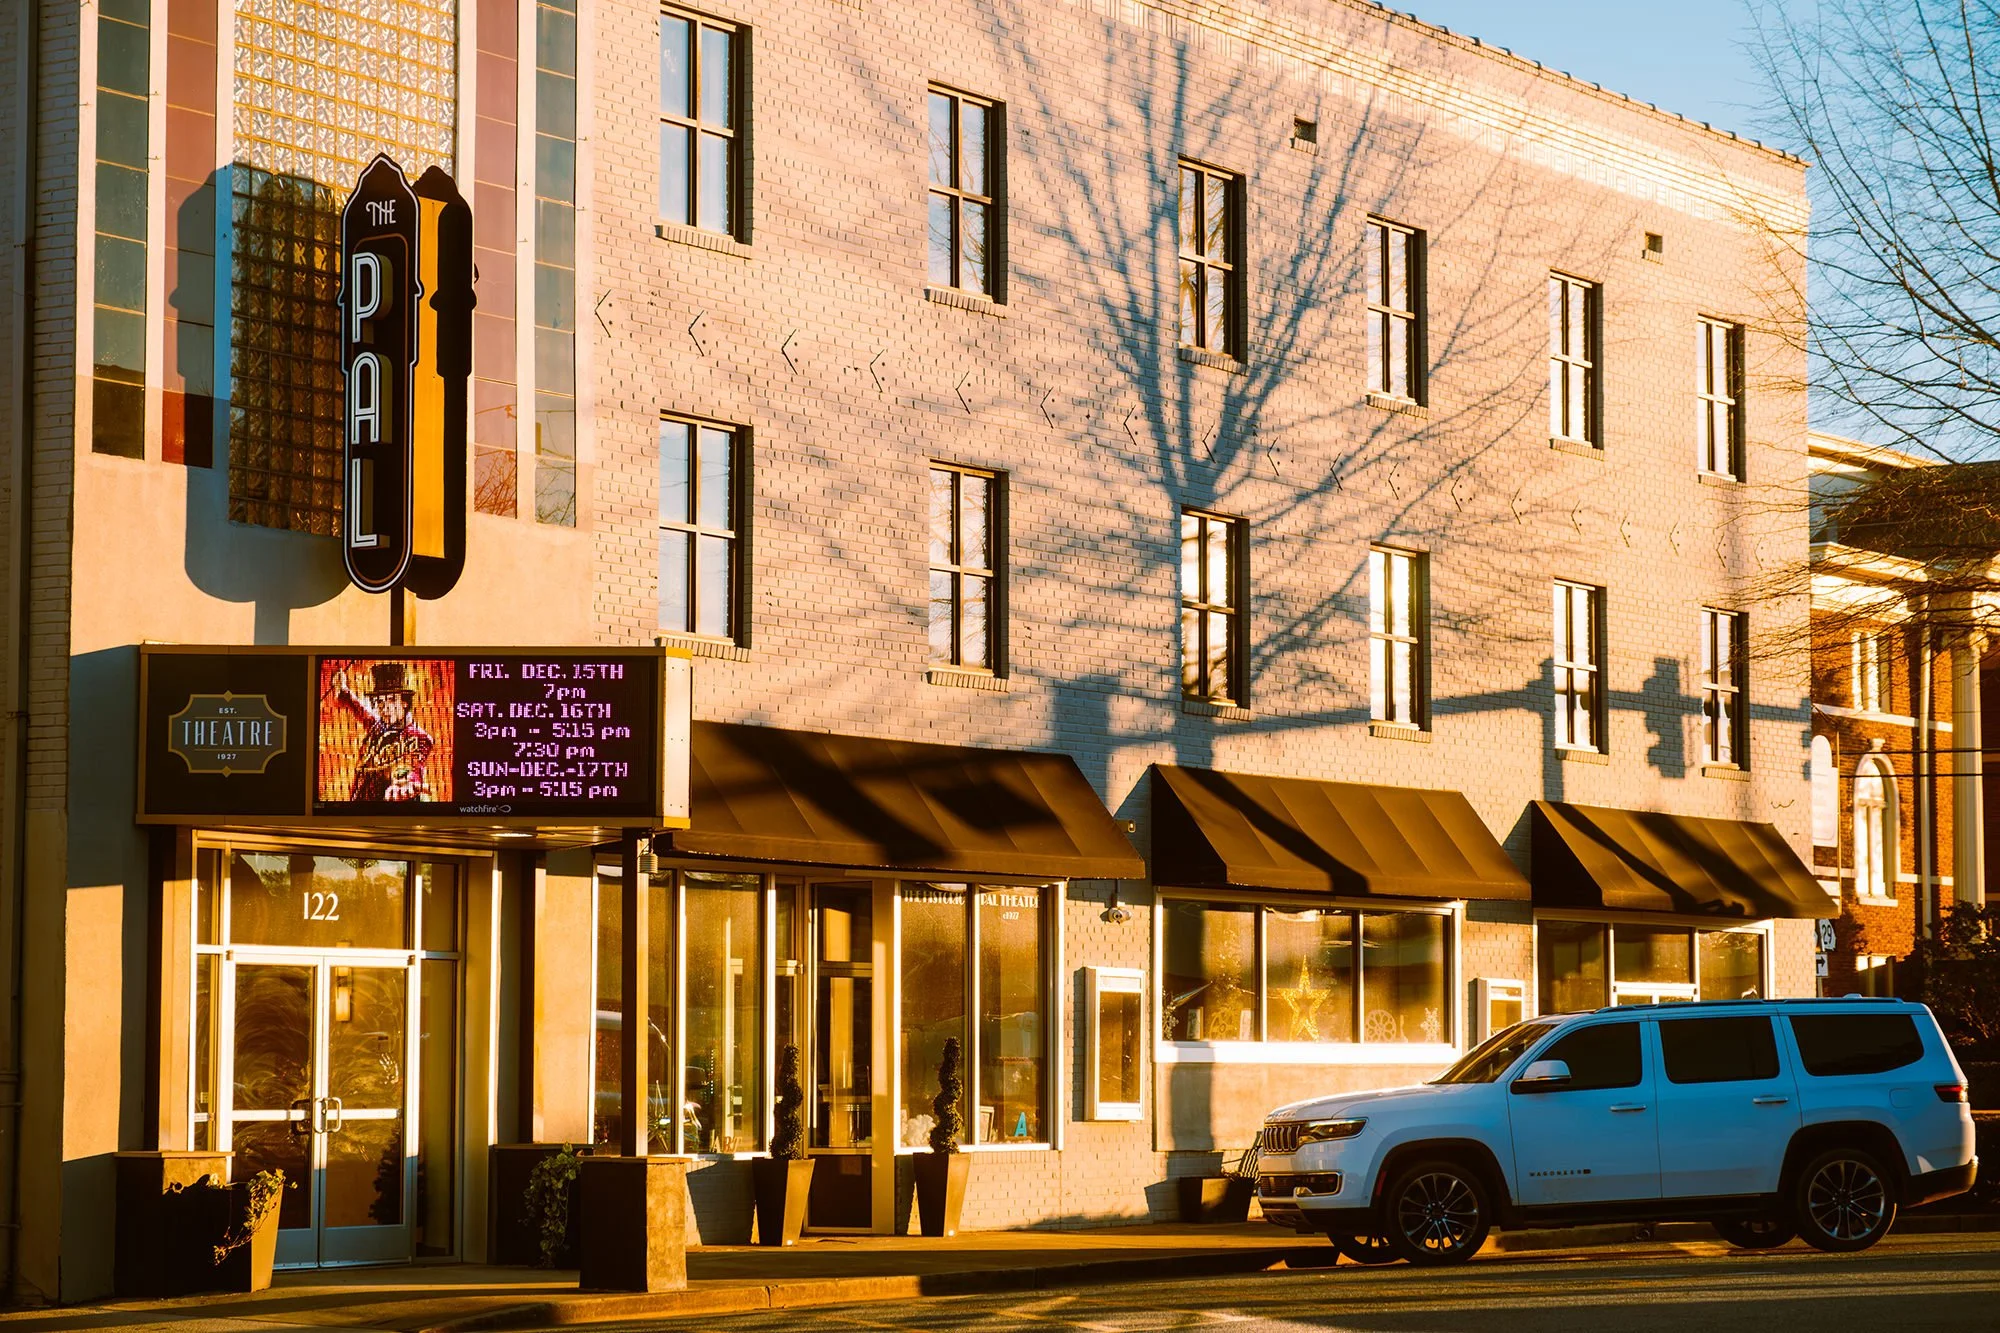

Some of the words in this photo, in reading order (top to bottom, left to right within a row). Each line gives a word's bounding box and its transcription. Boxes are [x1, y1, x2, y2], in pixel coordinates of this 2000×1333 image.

[366, 199, 397, 227] THE
[351, 251, 383, 549] PAL
[469, 663, 510, 679] FRI.
[573, 664, 624, 680] 15TH
[544, 683, 586, 701] 7pm
[457, 703, 504, 718] SAT.
[509, 703, 554, 719] DEC.
[561, 703, 612, 719] 16TH
[182, 720, 273, 746] THEATRE
[474, 722, 517, 740] 3pm
[552, 722, 595, 739] 5:15
[601, 726, 631, 740] pm
[513, 742, 560, 758] 7:30
[565, 746, 595, 760] pm
[473, 781, 516, 798] 3pm
[539, 781, 583, 797] 5:15
[588, 785, 618, 799] pm
[460, 804, 497, 813] watchfire
[303, 892, 340, 921] 122
[980, 893, 999, 907] PAL
[1821, 924, 1833, 945] 29
